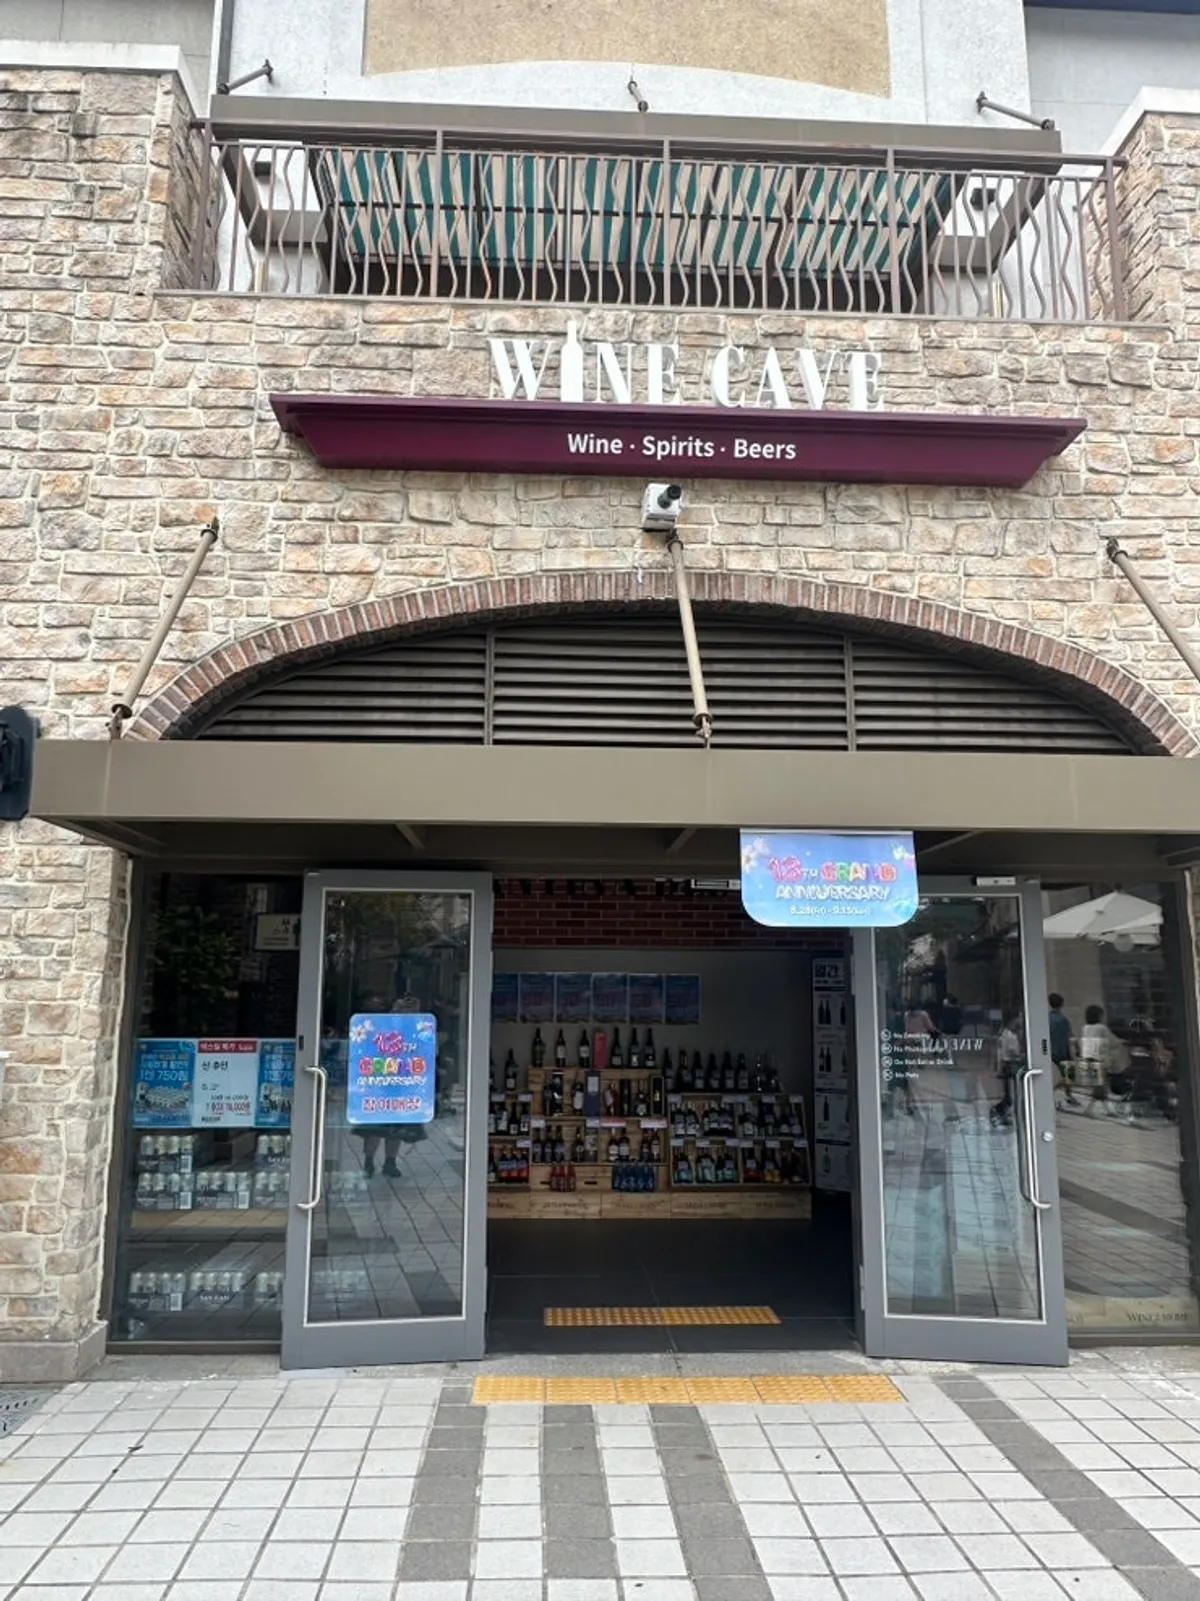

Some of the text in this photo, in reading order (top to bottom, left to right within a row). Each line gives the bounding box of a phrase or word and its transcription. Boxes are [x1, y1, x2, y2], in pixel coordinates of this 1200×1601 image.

[487, 320, 886, 411] WINE CAVE
[567, 433, 797, 460] Wine Spirits Beers
[820, 861, 897, 884] GRAND
[776, 884, 891, 901] ANNIVERSARY
